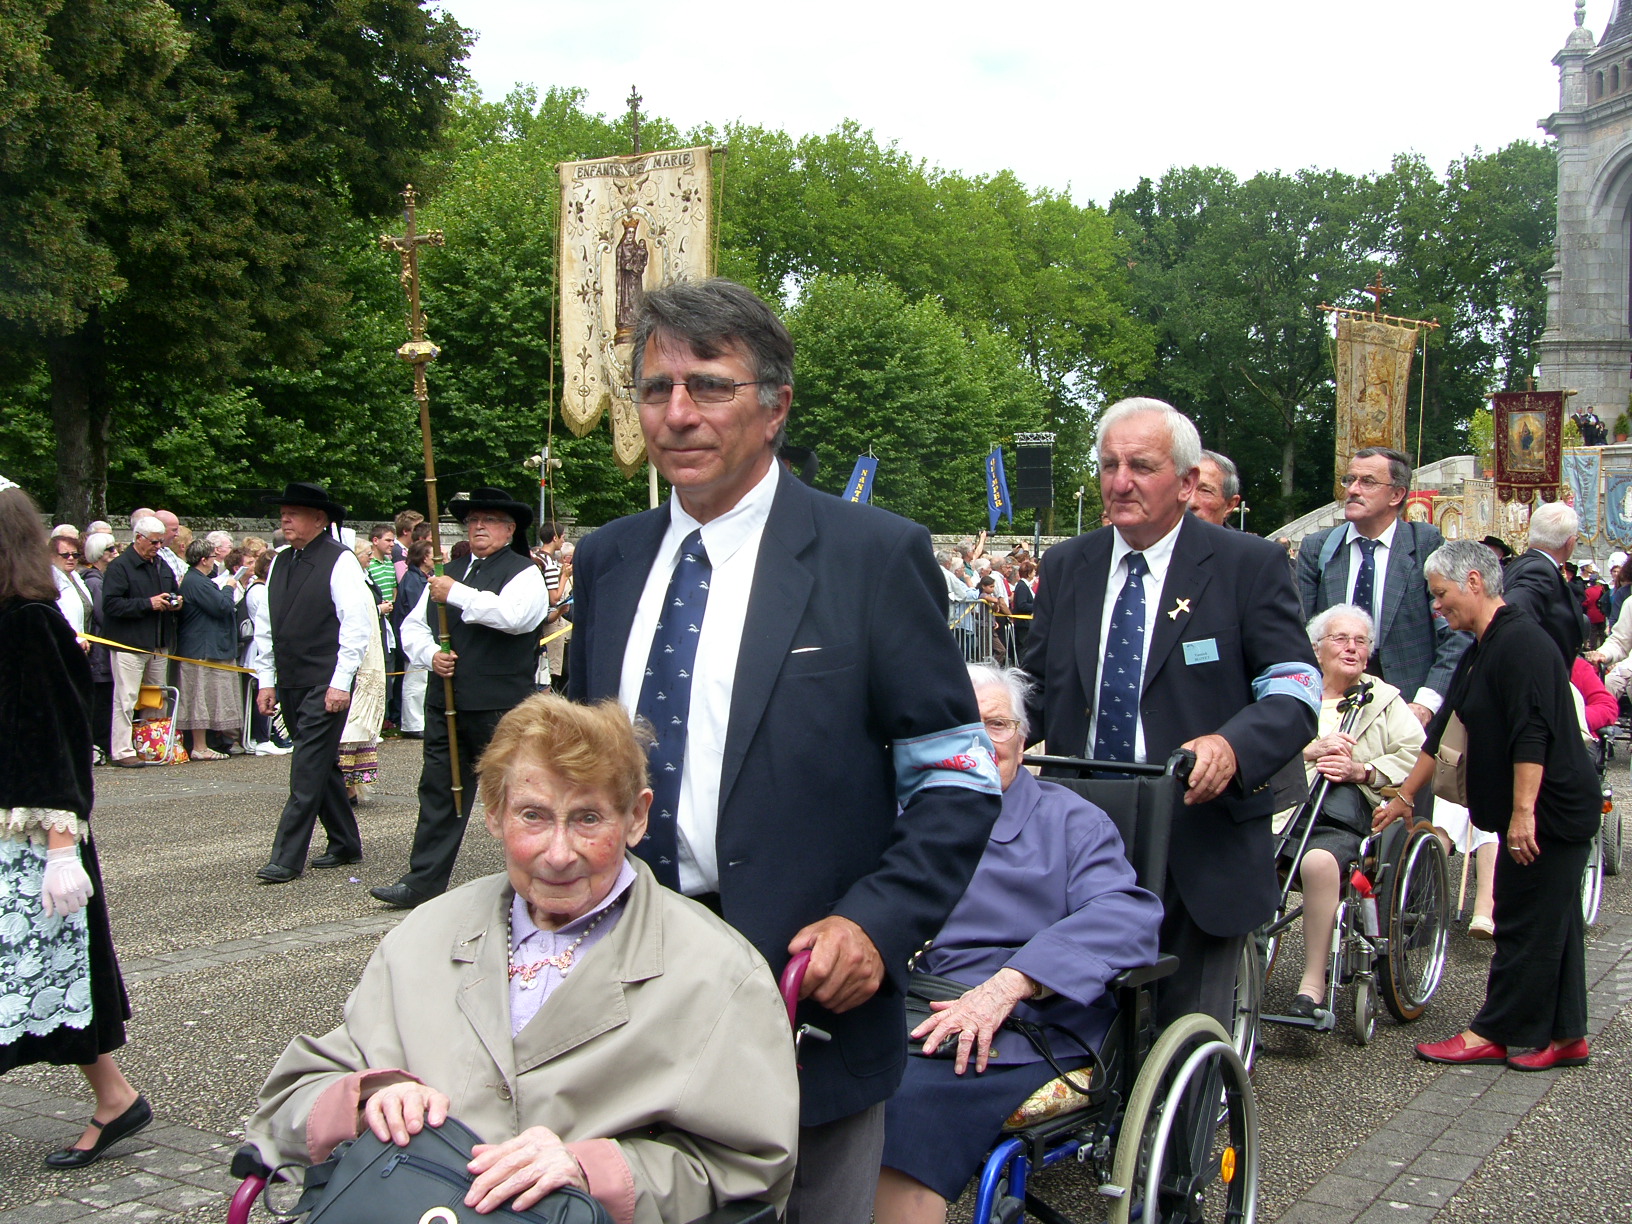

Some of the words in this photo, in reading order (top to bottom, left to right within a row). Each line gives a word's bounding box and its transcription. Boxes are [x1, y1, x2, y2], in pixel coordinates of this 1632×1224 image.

[577, 164, 621, 177] ENFANTS
[629, 164, 645, 177] DE
[653, 152, 691, 168] MARIE
[990, 458, 1003, 507] QUIMPER
[912, 754, 977, 771] NNES
